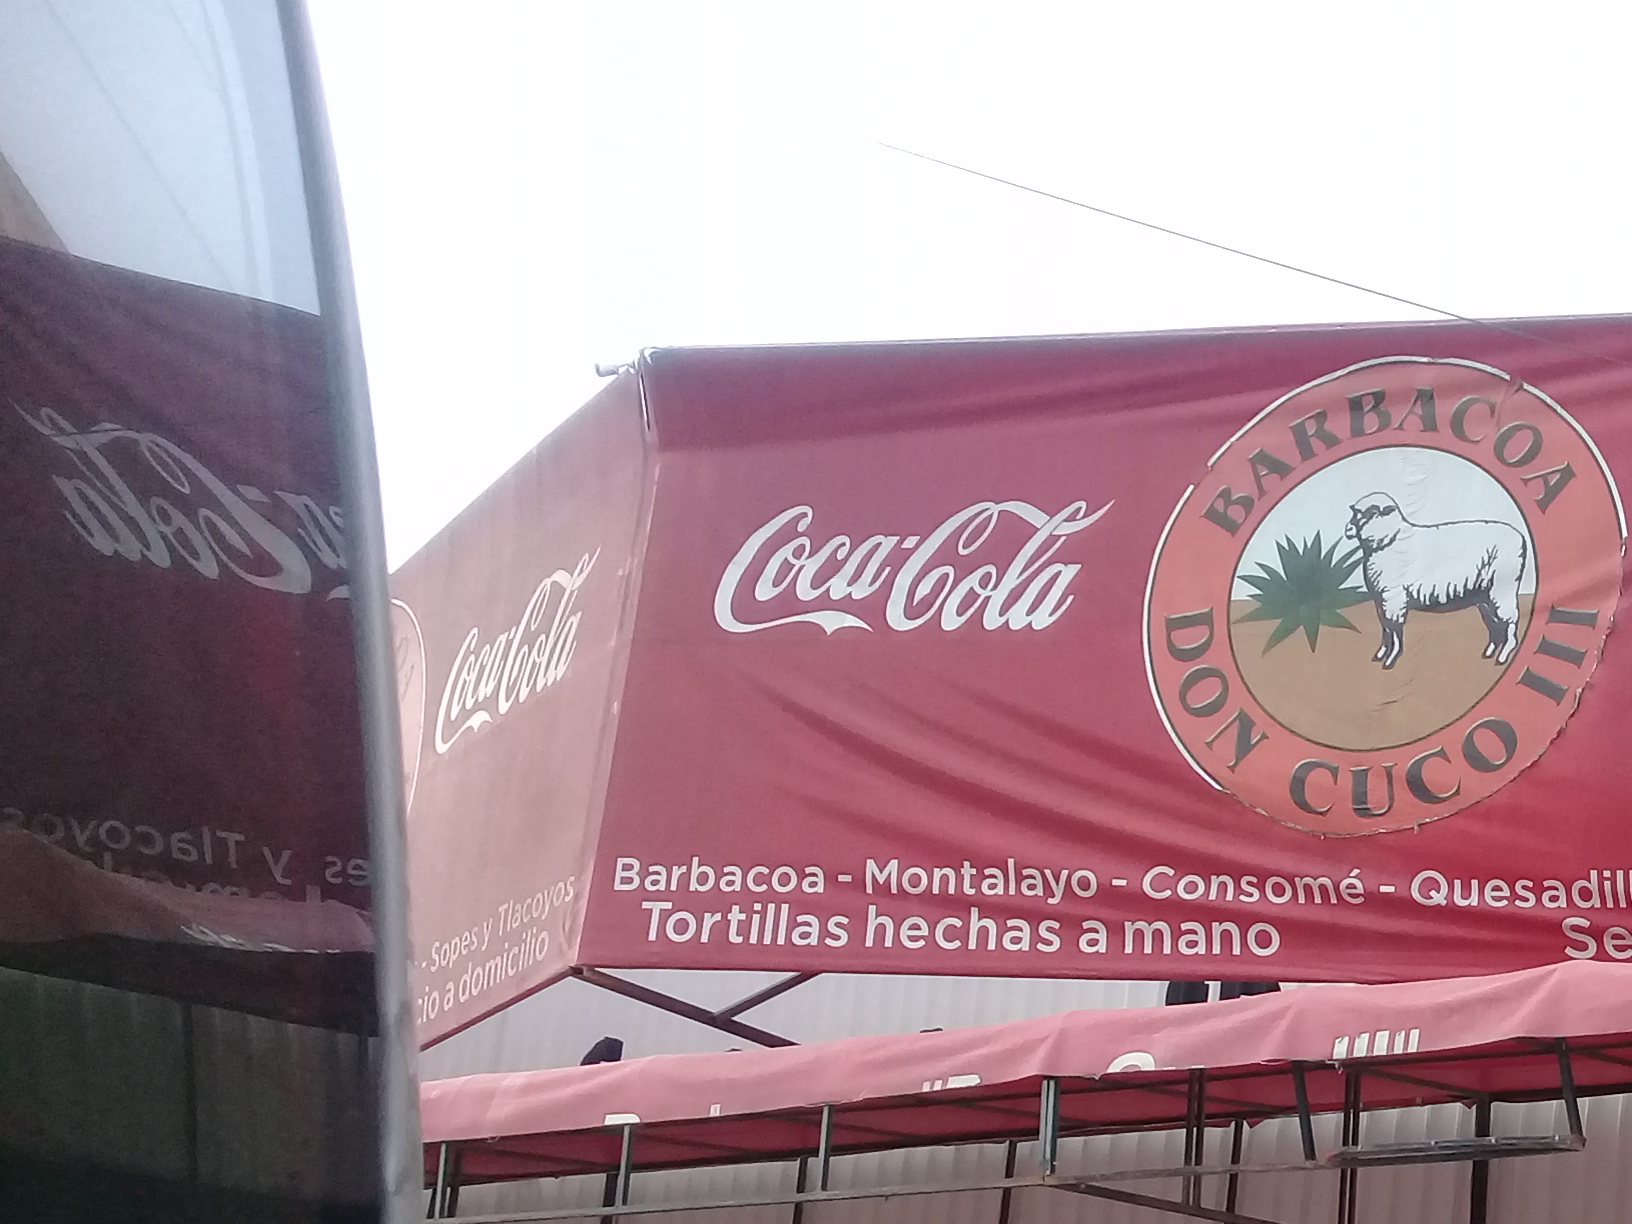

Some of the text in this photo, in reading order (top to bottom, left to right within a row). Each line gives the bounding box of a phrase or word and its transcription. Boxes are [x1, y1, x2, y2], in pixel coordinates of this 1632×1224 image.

[1201, 387, 1577, 537] BARBACOA
[713, 499, 1115, 636] Coca-Cola
[434, 546, 602, 756] Coca-Cola
[1164, 603, 1600, 819] DON CUCO III
[430, 926, 479, 973] Sopes
[481, 917, 494, 952] y
[498, 875, 576, 937] Tlacoyos
[613, 857, 826, 895] Barbacoa
[864, 858, 1099, 906] Montalayo
[1141, 866, 1366, 905] Consomé
[641, 901, 1281, 957] Tortillas hechas a mano
[443, 980, 455, 1012] a
[458, 926, 549, 1004] domicilio
